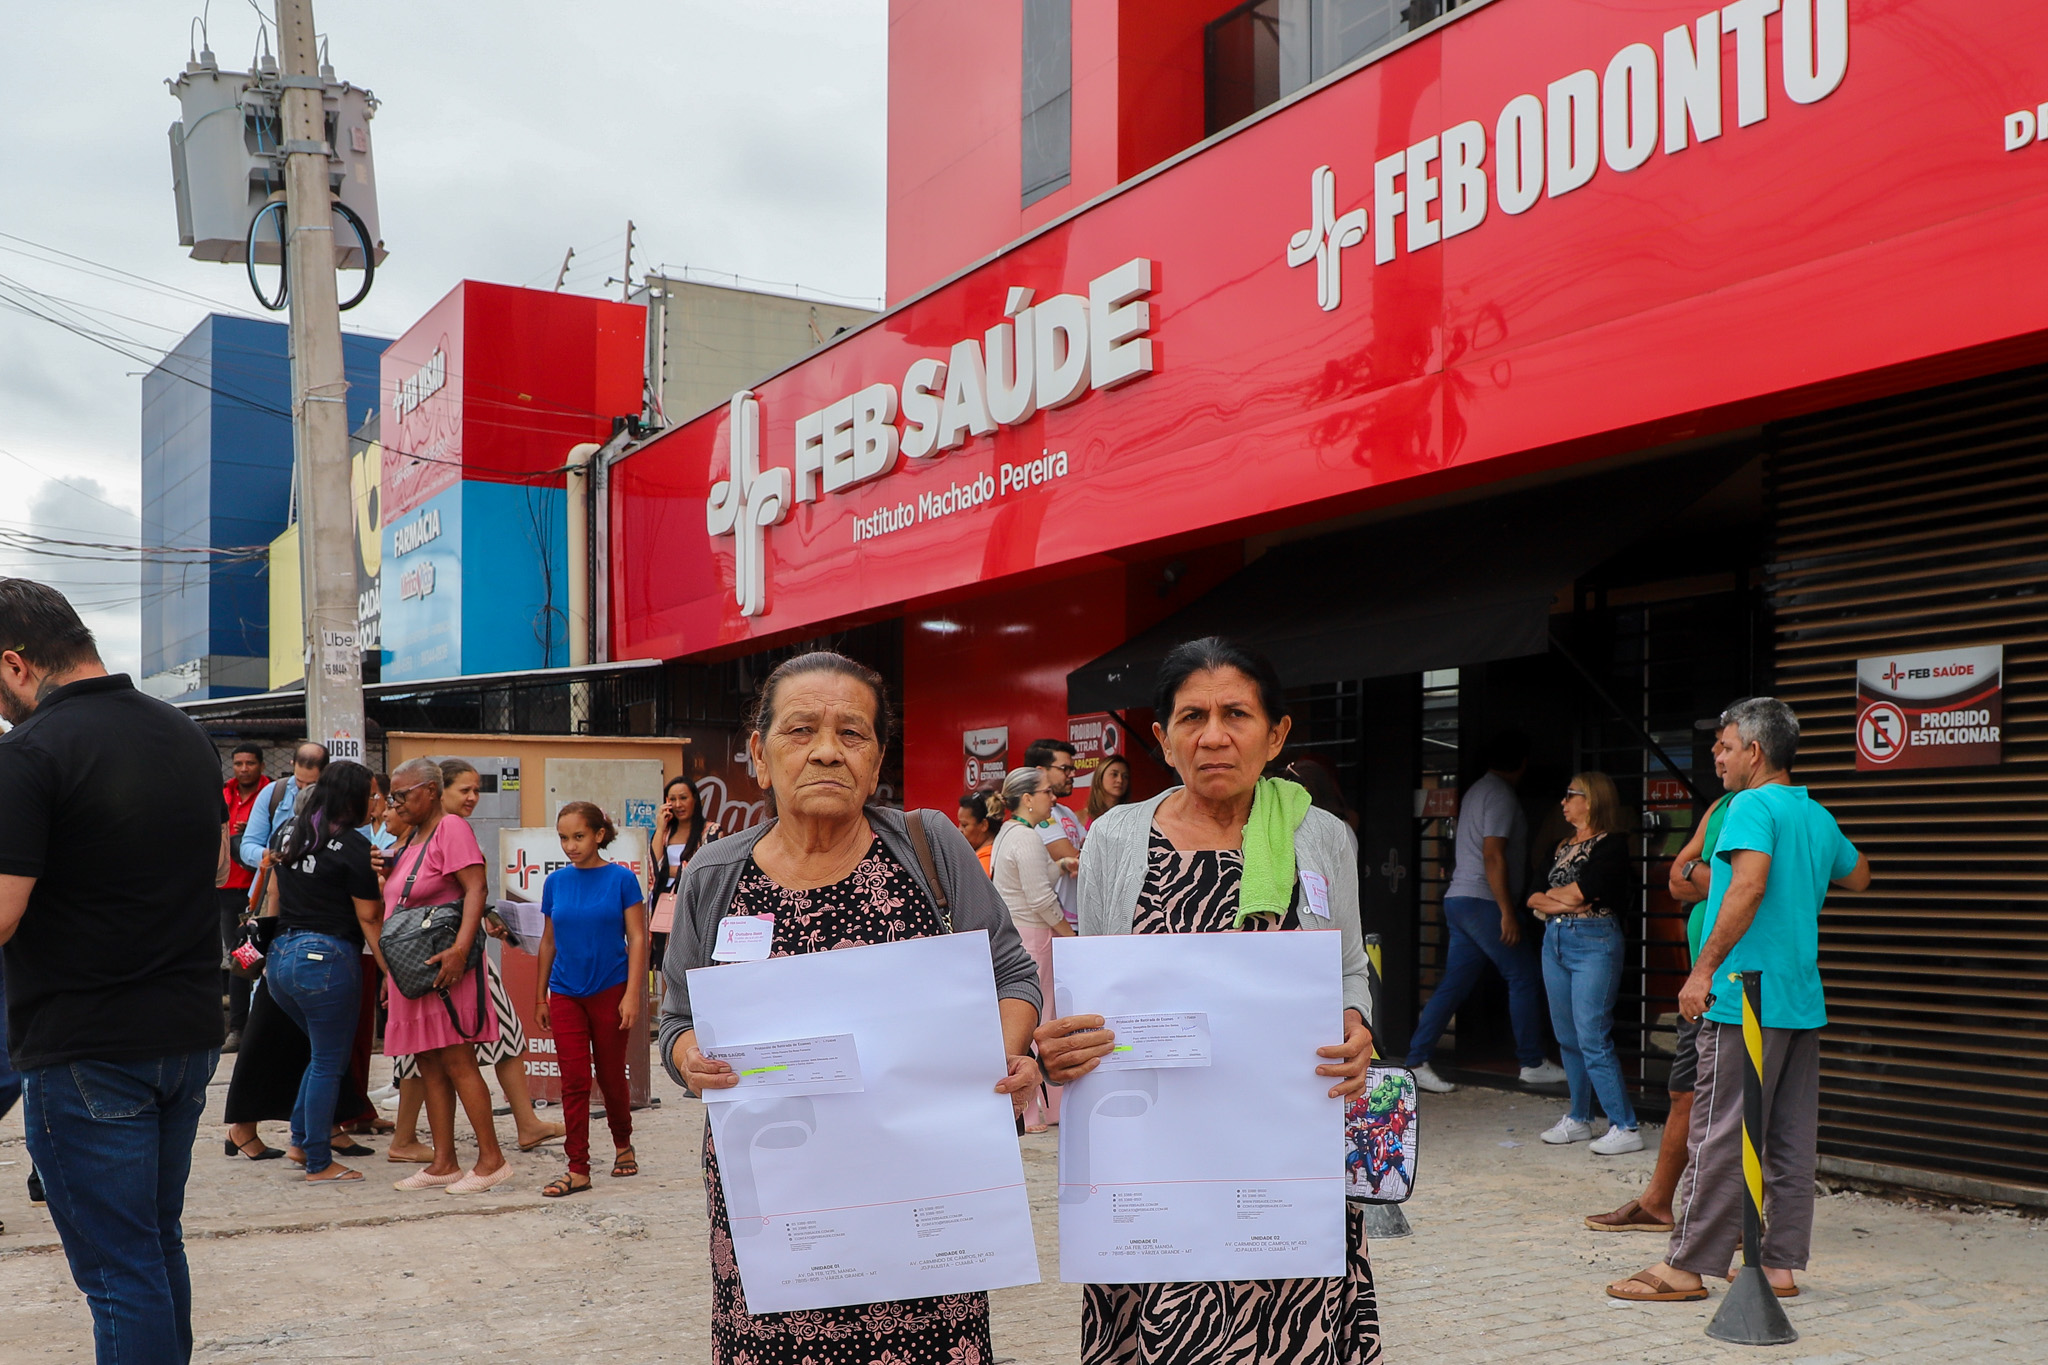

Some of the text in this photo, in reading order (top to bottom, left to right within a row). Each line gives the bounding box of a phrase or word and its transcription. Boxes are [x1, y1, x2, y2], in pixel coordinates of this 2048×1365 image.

[1374, 0, 1849, 266] FEB ODONTO
[795, 257, 1153, 504] FEB SAÚDE
[852, 449, 1069, 543] Instituto Machado Pereira
[394, 508, 441, 558] FARMÁCIA
[360, 620, 381, 653] ÓCUL
[1908, 663, 1974, 680] FEB SAÚDE
[1920, 709, 1990, 729] PROIBIDO
[1070, 722, 1102, 741] PROIBIDO
[1910, 726, 2000, 747] ESTACIONAR
[327, 739, 359, 758] UBER
[1071, 740, 1098, 752] NTRAR
